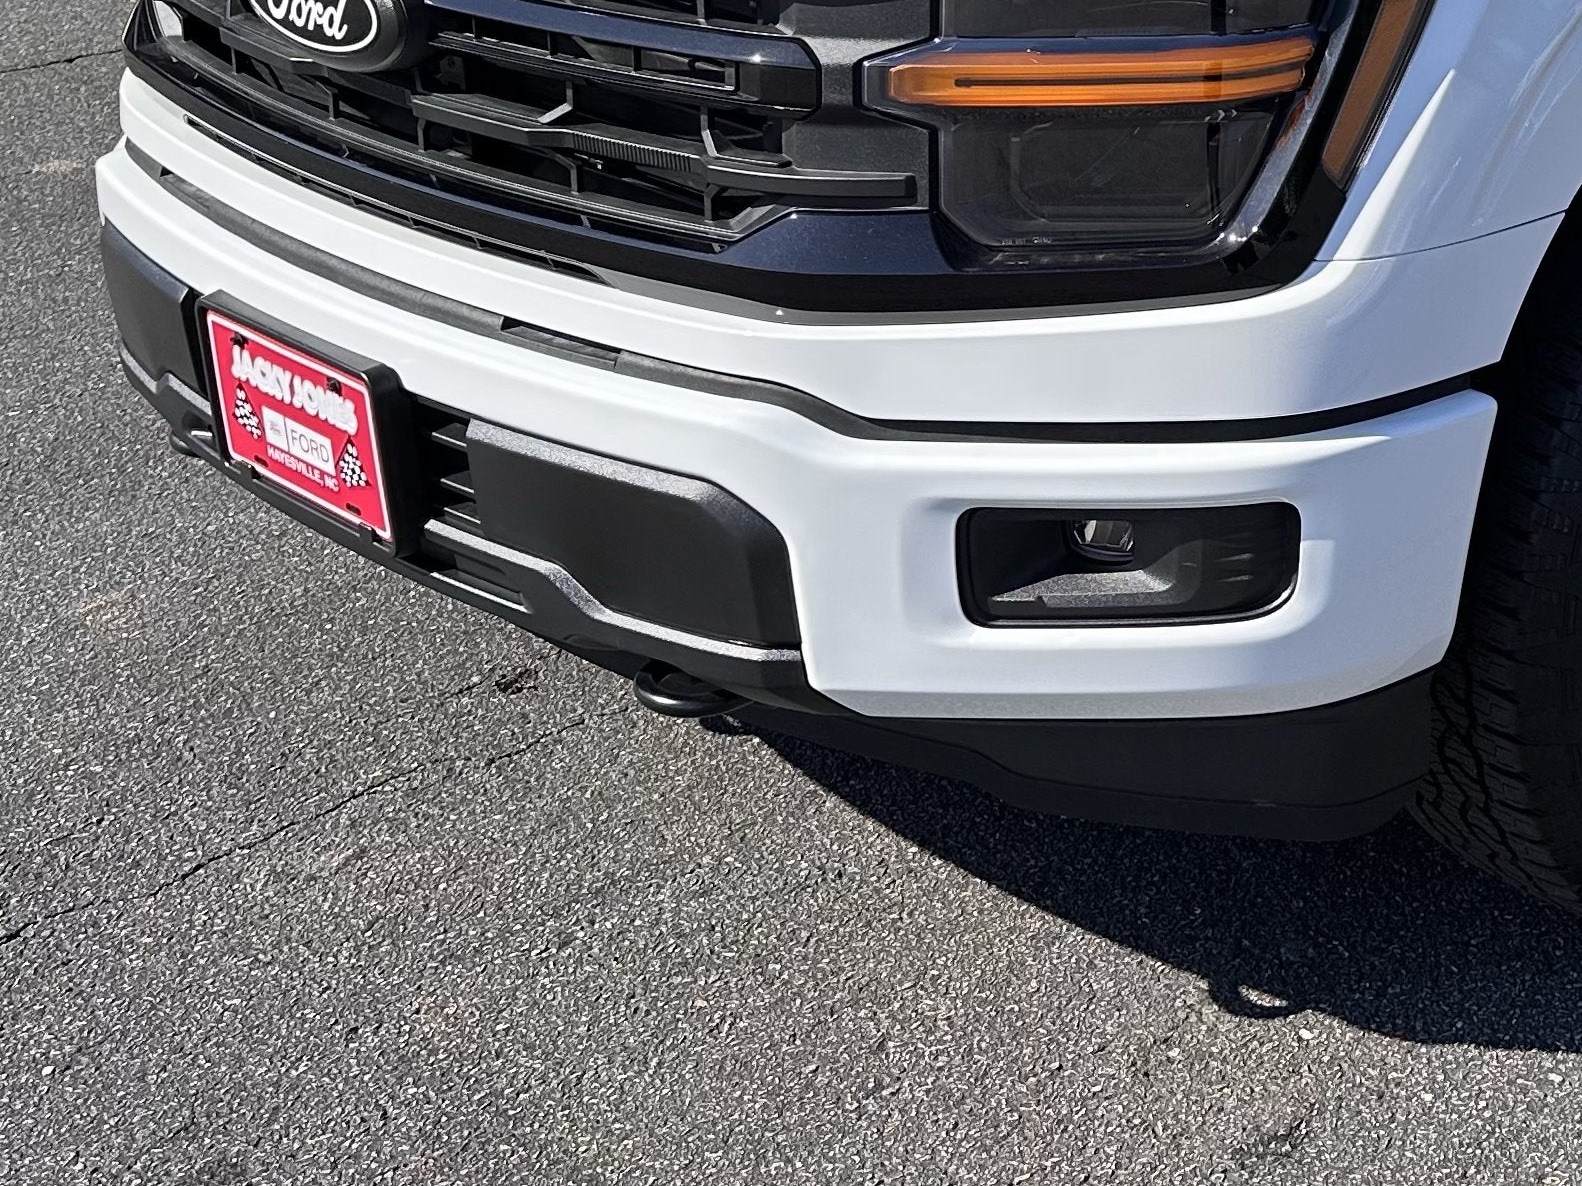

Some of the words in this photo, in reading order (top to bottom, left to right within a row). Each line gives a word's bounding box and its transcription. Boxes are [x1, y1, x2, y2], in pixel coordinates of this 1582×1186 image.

[231, 345, 292, 405] JACKY
[292, 375, 358, 436] JONES
[290, 428, 330, 463] FORD
[324, 473, 339, 492] NC
